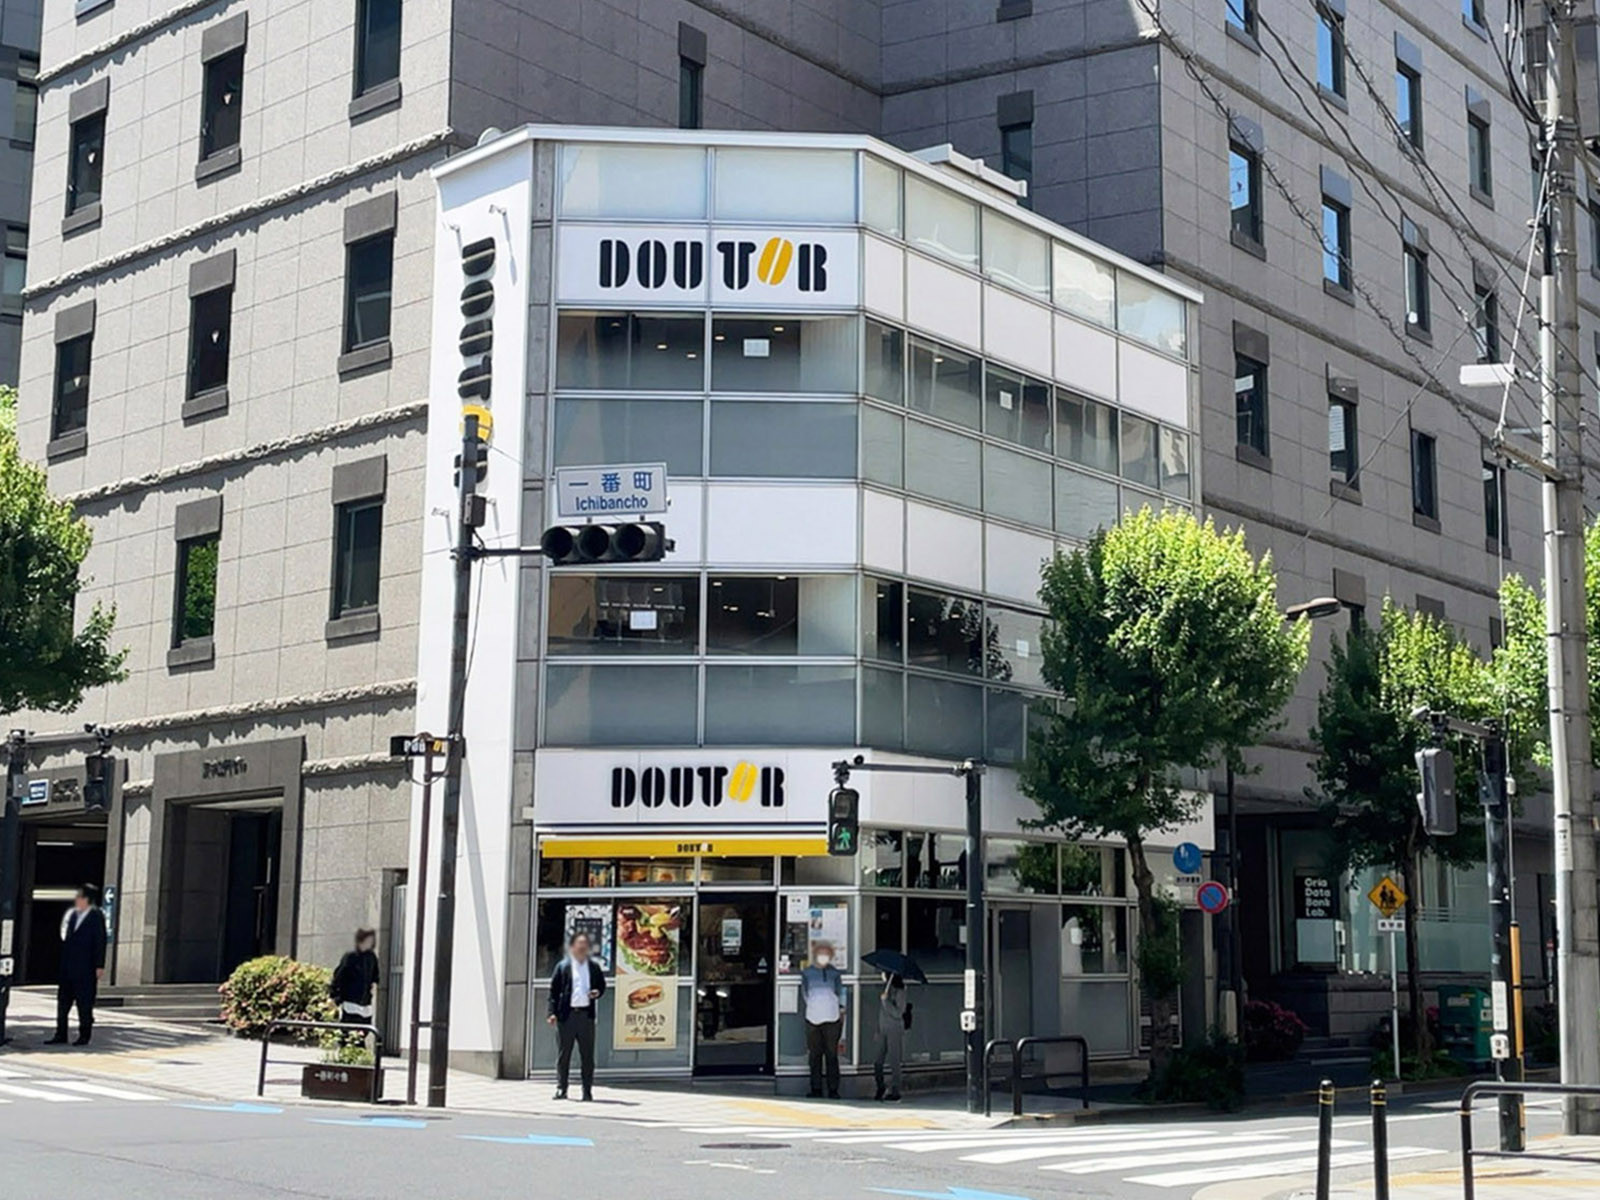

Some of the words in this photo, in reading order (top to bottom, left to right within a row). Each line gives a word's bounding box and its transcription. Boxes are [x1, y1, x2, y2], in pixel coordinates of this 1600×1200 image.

[599, 237, 827, 292] DOUTOR
[568, 471, 653, 493] 一番町
[575, 494, 648, 512] Ichibancho
[611, 761, 785, 808] DOUTOR
[1305, 888, 1331, 897] Data
